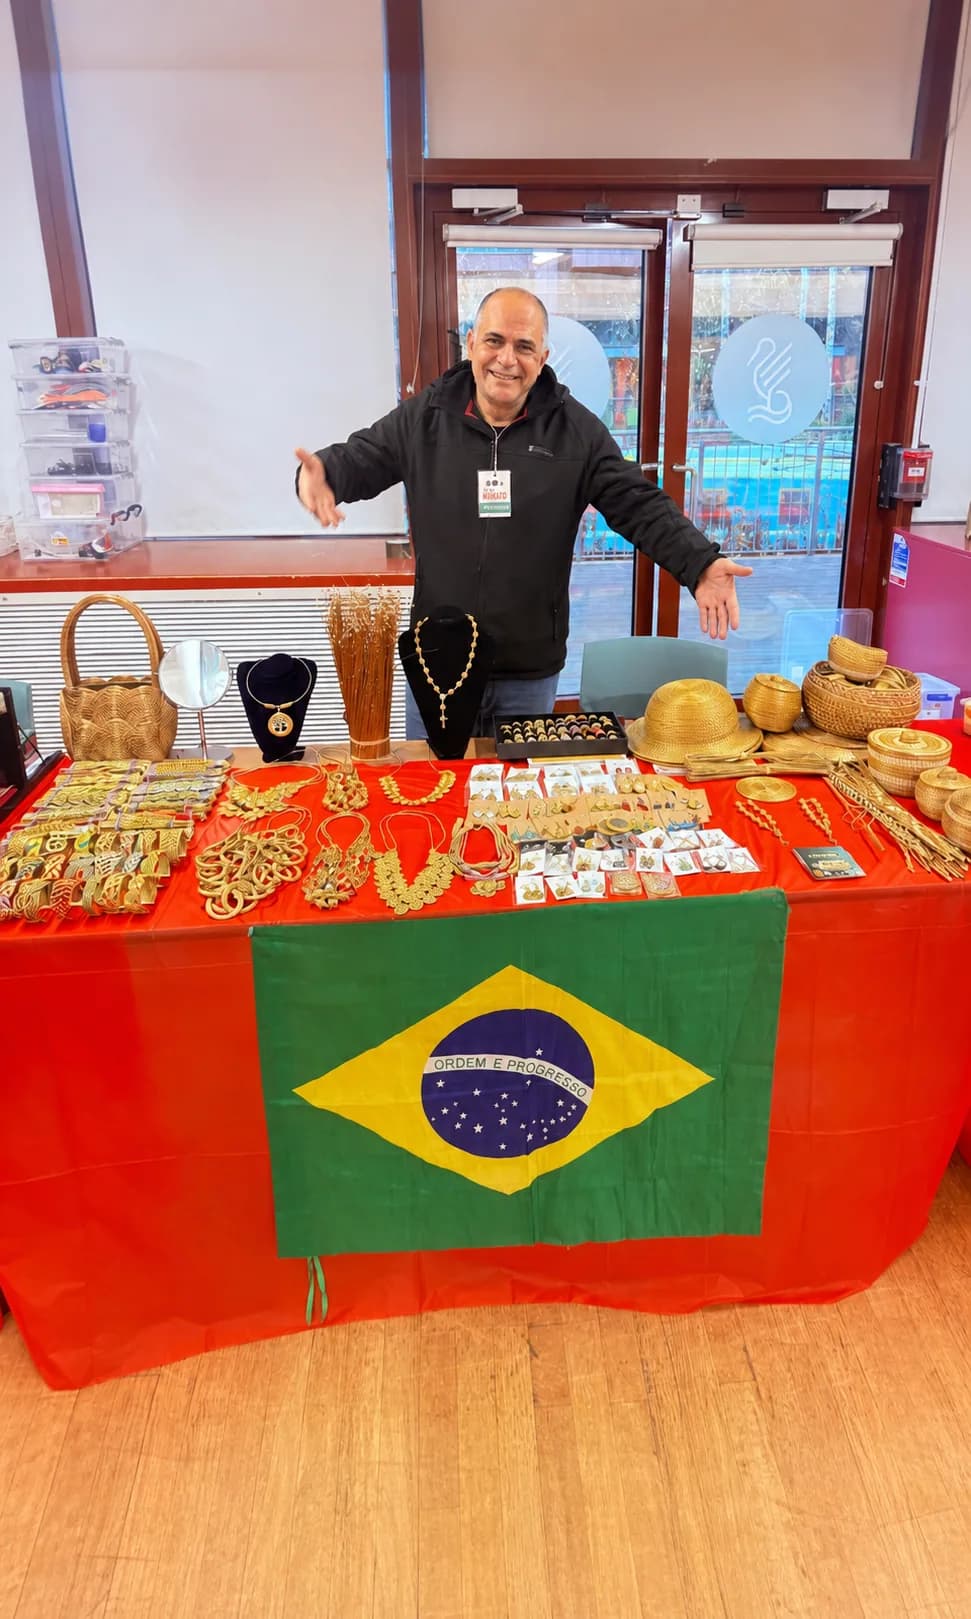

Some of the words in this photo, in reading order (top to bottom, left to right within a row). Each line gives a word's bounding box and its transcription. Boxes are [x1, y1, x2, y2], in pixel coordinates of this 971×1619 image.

[434, 1057, 487, 1070] ORDEM
[493, 1058, 502, 1069] E
[506, 1059, 588, 1098] PROGRESSO
